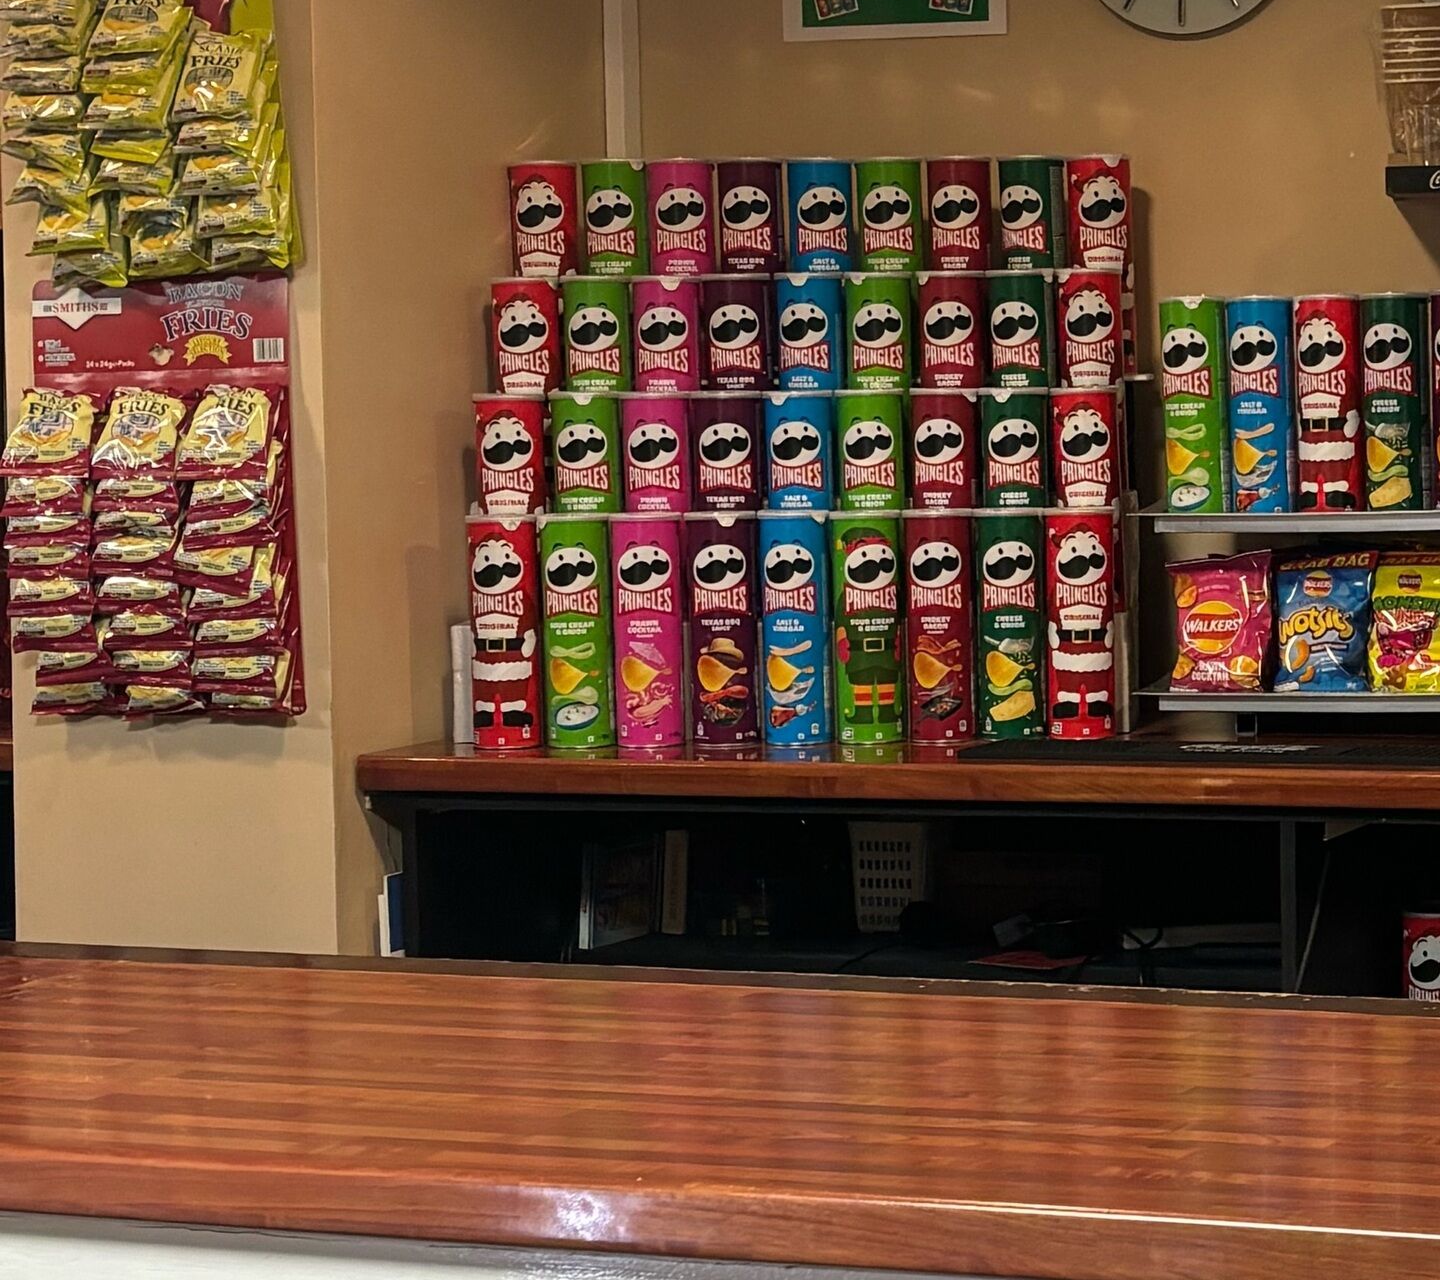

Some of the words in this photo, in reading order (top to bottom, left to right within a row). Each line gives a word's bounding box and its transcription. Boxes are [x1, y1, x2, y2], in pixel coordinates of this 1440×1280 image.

[517, 231, 564, 255] PRINGLES
[587, 230, 635, 255] PRINGLES
[657, 230, 706, 253] PRINGLES
[723, 227, 771, 252] PRINGLES
[798, 227, 847, 252] PRINGLES
[864, 227, 913, 251] PRINGLES
[933, 226, 979, 250] PRINGLES
[1080, 225, 1127, 249] PRINGLES
[166, 281, 244, 305] BACON
[51, 302, 99, 314] SMITHS
[160, 306, 253, 342] FRIES
[500, 350, 549, 375] PRINGLES
[569, 349, 620, 374] PRINGLES
[639, 349, 688, 373] PRINGLES
[711, 345, 760, 370] PRINGLES
[781, 345, 828, 369] PRINGLES
[854, 345, 903, 370] PRINGLES
[925, 343, 973, 367] PRINGLES
[993, 342, 1039, 367] PRINGLES
[1066, 340, 1115, 364] PRINGLES
[1163, 370, 1209, 396] PRINGLES
[1231, 369, 1277, 395] PRINGLES
[1299, 370, 1345, 395] PRINGLES
[1365, 366, 1412, 393] PRINGLES
[118, 400, 170, 416] FRIES
[482, 467, 534, 493] PRINGLES
[557, 465, 608, 492] PRINGLES
[629, 466, 680, 491] PRINGLES
[701, 464, 752, 489] PRINGLES
[772, 462, 821, 488] PRINGLES
[845, 462, 894, 487] PRINGLES
[915, 460, 964, 485] PRINGLES
[989, 460, 1039, 486] PRINGLES
[1062, 459, 1110, 484] PRINGLES
[1332, 553, 1370, 566] BAG
[472, 590, 523, 615] PRINGLES
[547, 589, 598, 615] PRINGLES
[618, 589, 672, 614] PRINGLES
[694, 587, 746, 612] PRINGLES
[765, 586, 814, 612] PRINGLES
[846, 587, 897, 612] PRINGLES
[911, 585, 962, 609] PRINGLES
[984, 584, 1035, 609] PRINGLES
[1056, 582, 1107, 607] PRINGLES
[1186, 618, 1239, 634] WALKERS
